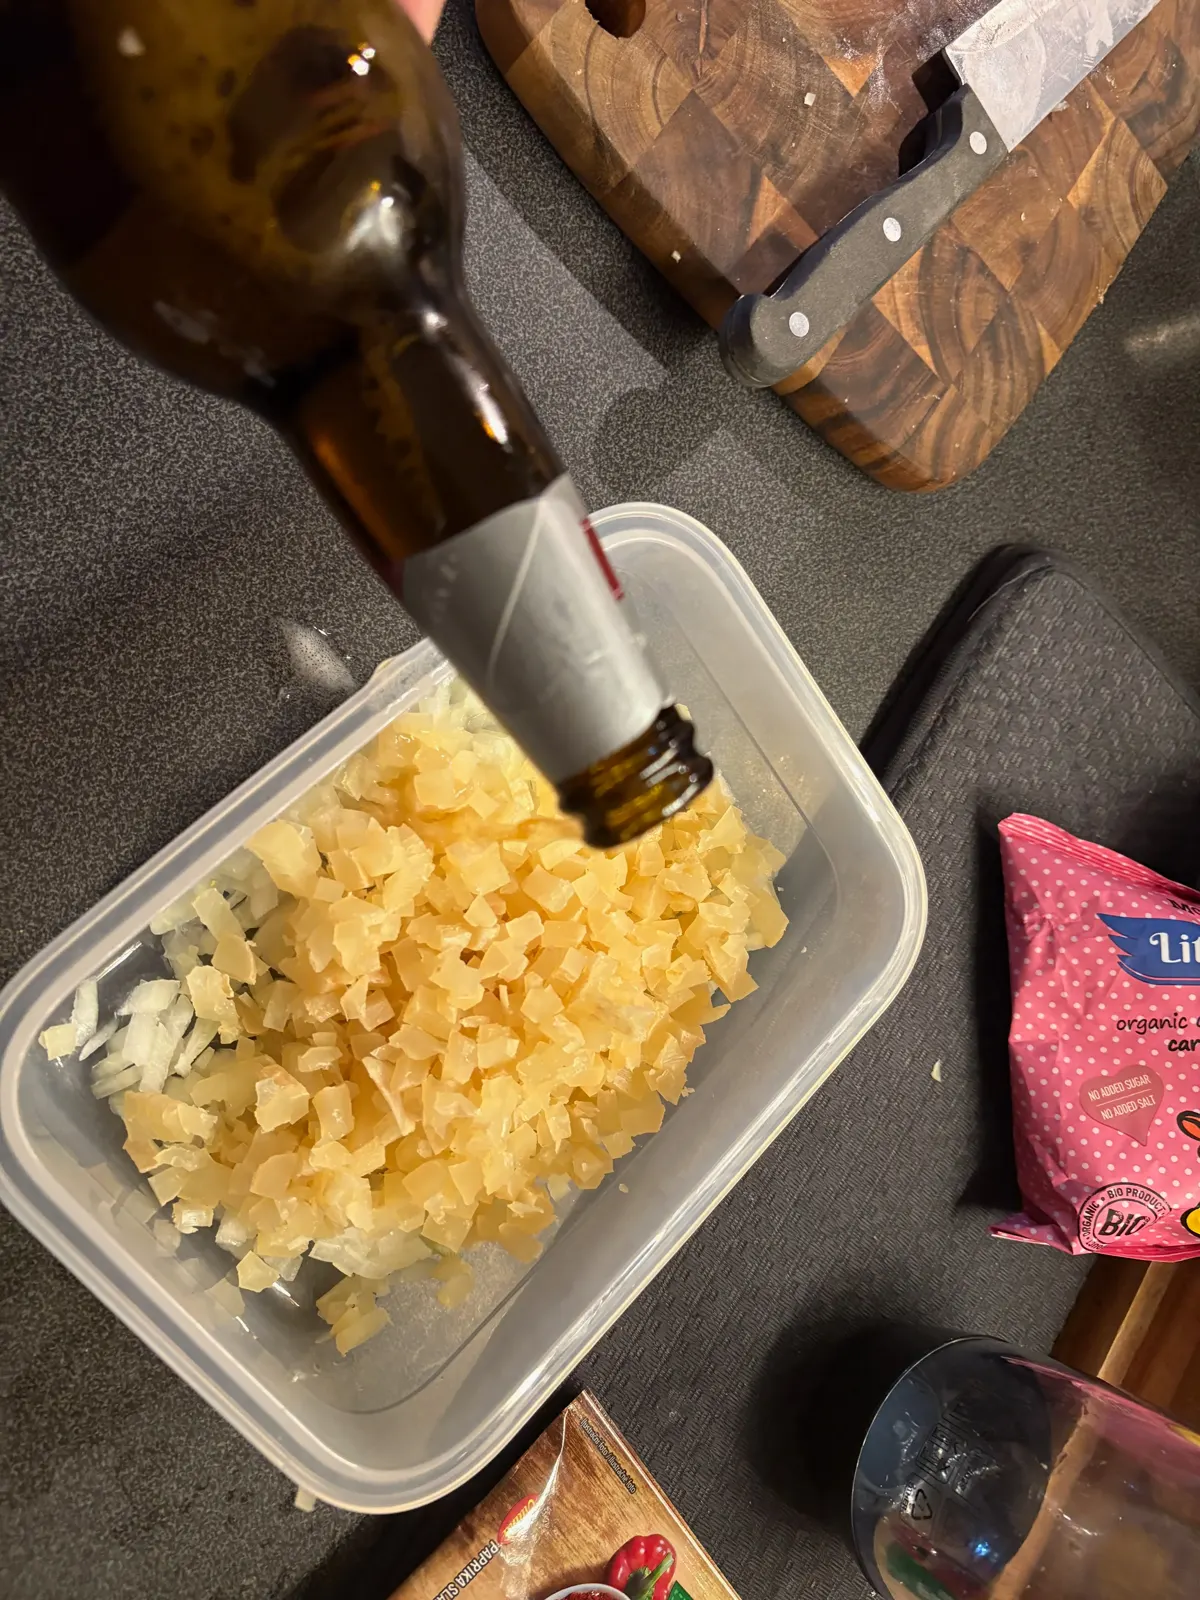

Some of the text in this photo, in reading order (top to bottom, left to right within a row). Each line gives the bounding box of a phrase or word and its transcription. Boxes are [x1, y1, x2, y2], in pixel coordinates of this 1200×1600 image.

[1116, 1012, 1188, 1035] organic
[1168, 1039, 1200, 1052] car
[1088, 1074, 1152, 1102] NO ADDED SUGAR
[1101, 1095, 1156, 1120] NO ADDED SALT
[1107, 1187, 1166, 1213] BIO PRODUCT
[1081, 1200, 1100, 1238] ORGANIC
[626, 1479, 637, 1494] foto
[454, 1540, 500, 1588] PAPRIKA
